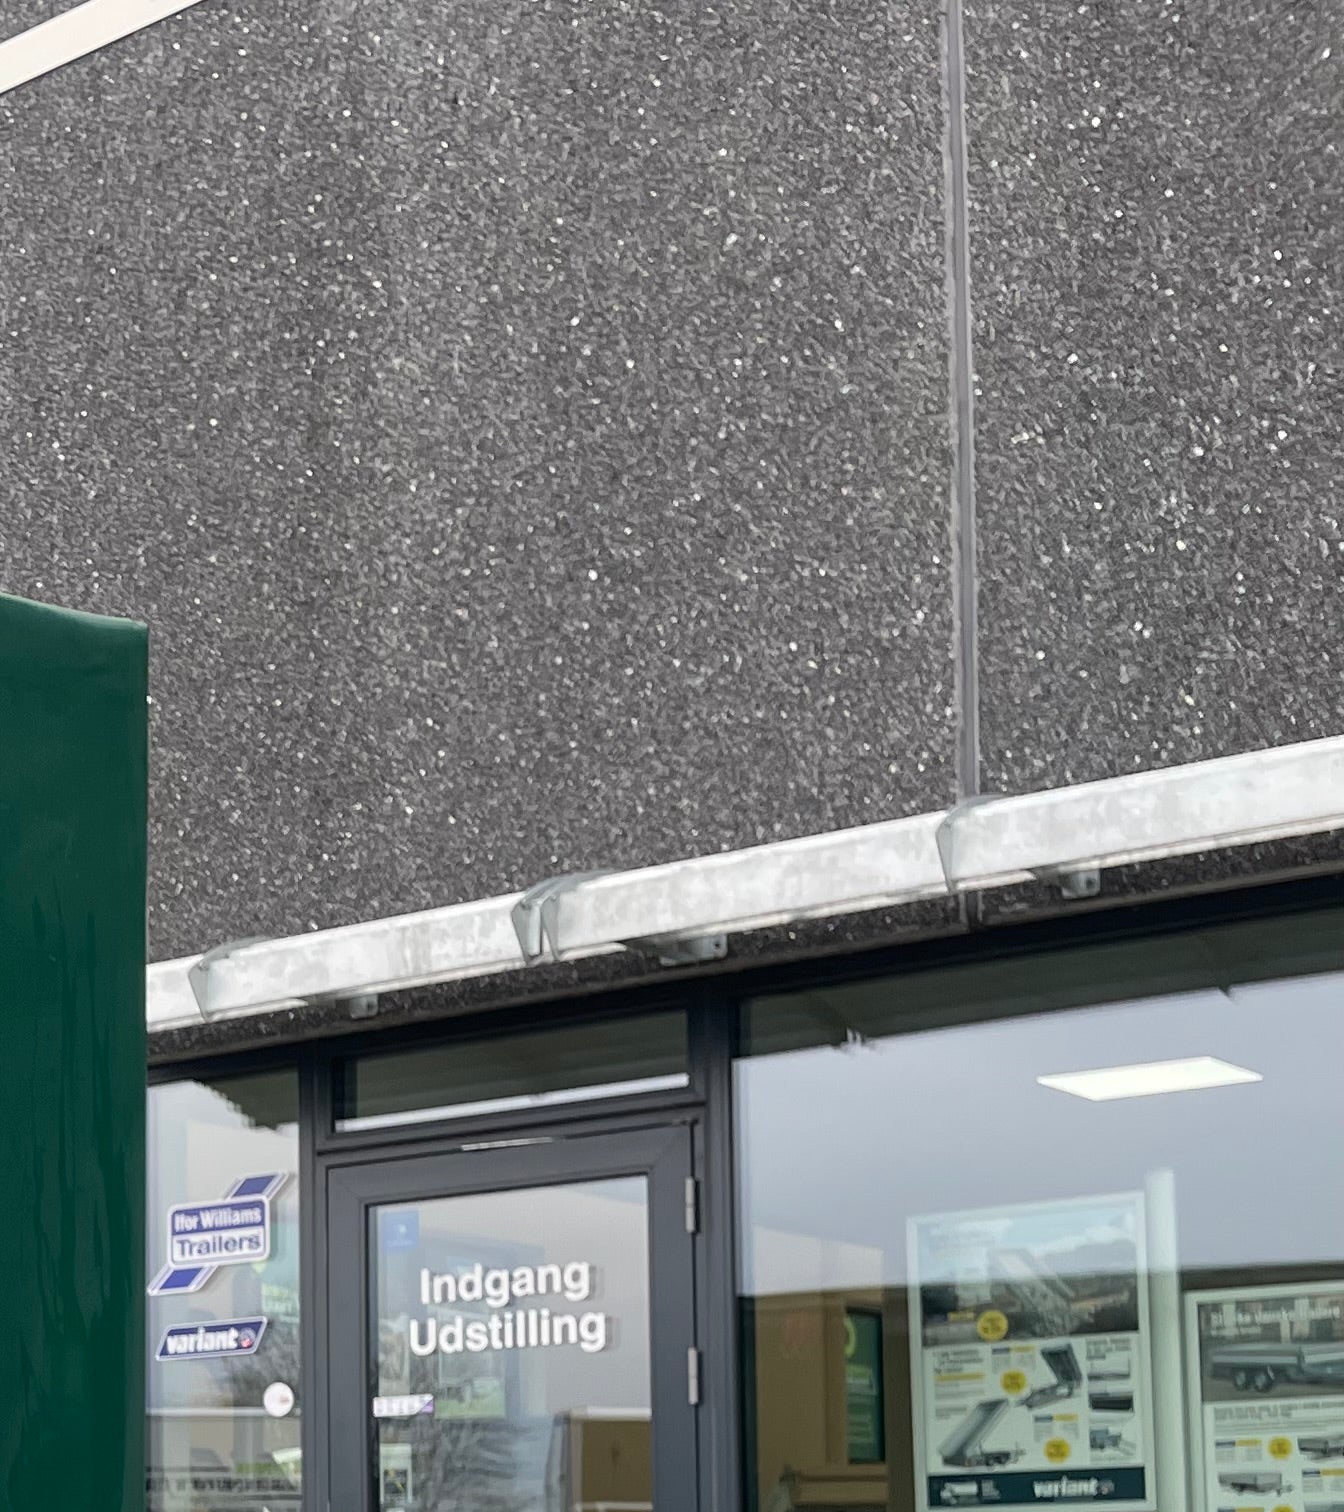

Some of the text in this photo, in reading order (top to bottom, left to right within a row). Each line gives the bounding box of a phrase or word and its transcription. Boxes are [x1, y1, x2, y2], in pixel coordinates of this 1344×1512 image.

[201, 1207, 262, 1229] Williams
[176, 1234, 262, 1257] Trailers
[420, 1261, 590, 1308] Indgang
[166, 1326, 239, 1354] variant
[410, 1307, 607, 1356] Udstilling
